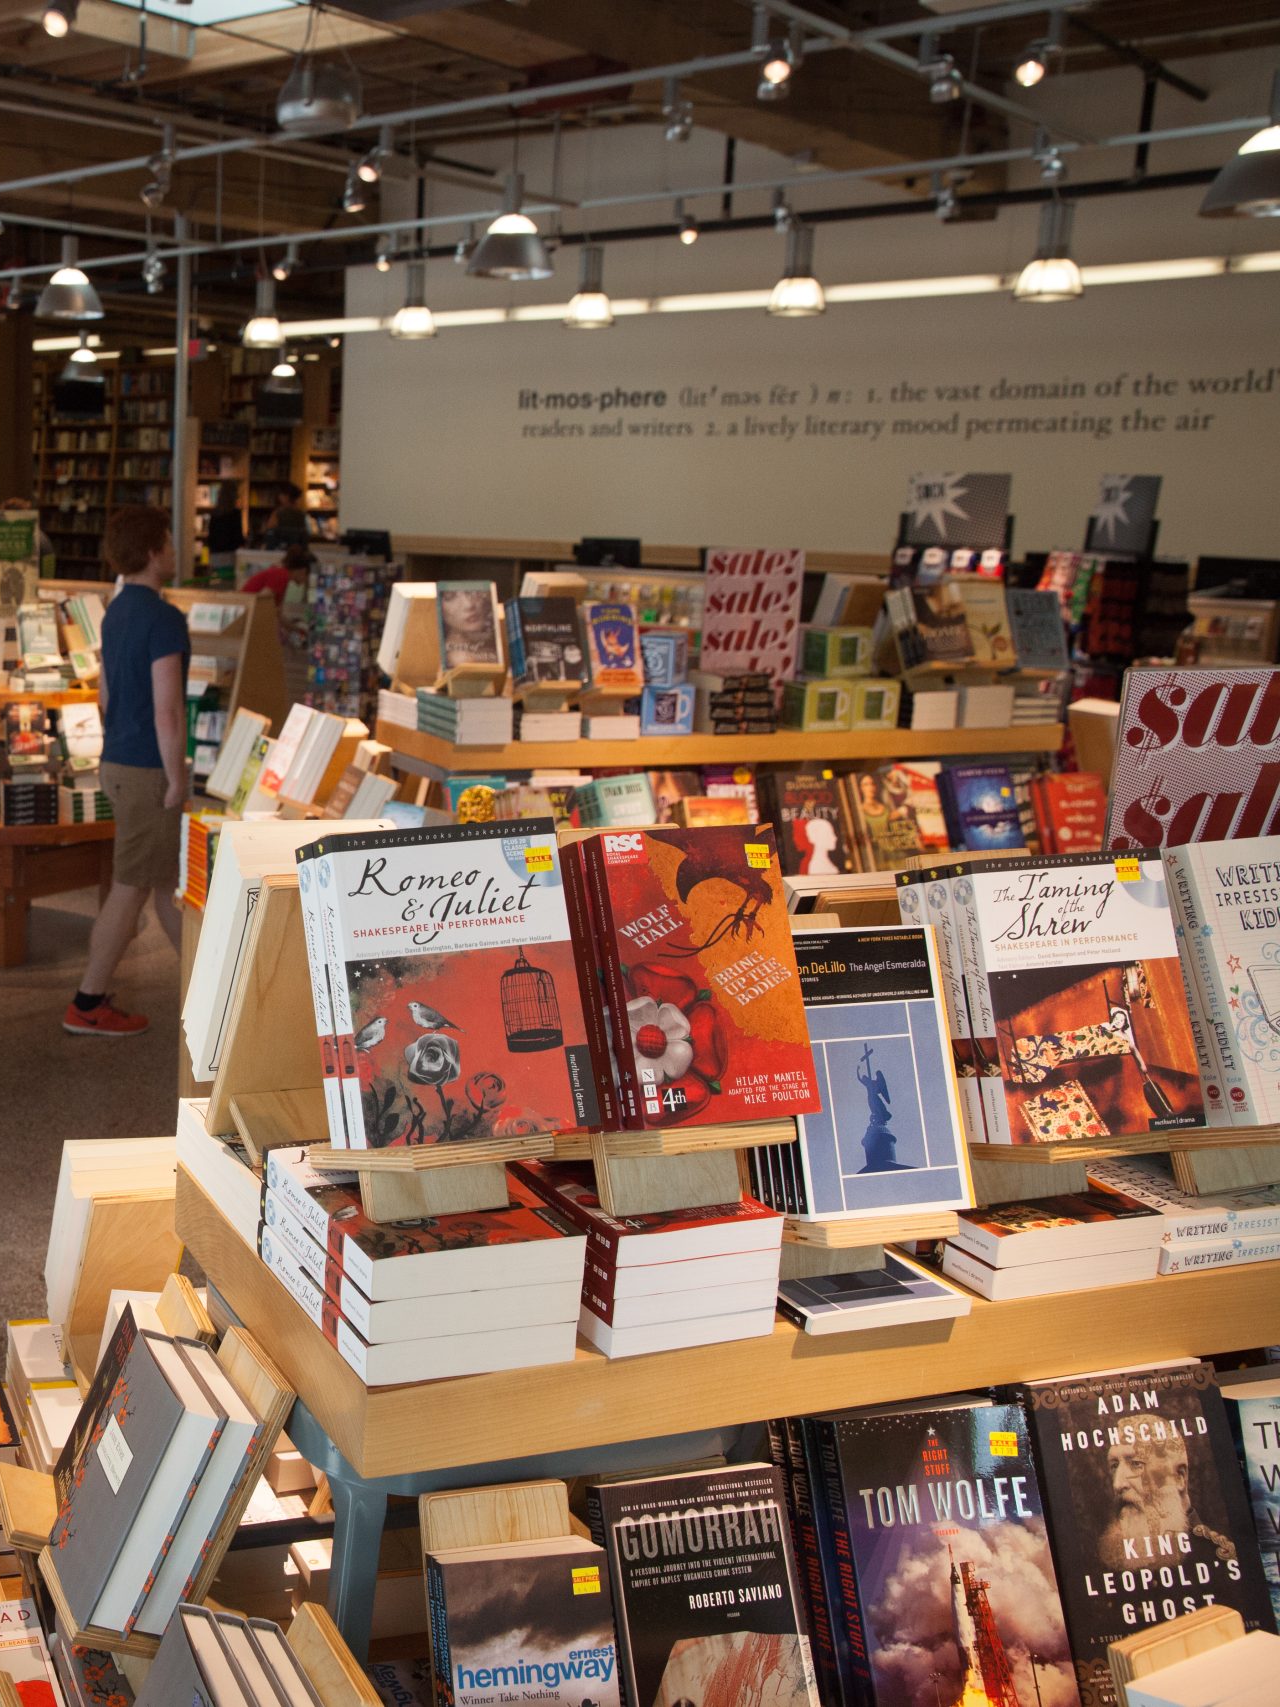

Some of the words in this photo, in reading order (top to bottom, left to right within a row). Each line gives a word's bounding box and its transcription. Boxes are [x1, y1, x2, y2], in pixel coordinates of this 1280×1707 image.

[890, 381, 927, 402] the
[934, 383, 981, 401] vast
[989, 376, 1086, 400] domain
[1094, 372, 1128, 396] of
[1133, 373, 1178, 396] the
[522, 418, 584, 438] readers
[589, 418, 623, 437] and
[628, 419, 694, 437] writers
[745, 415, 799, 442] lively
[806, 414, 885, 442] literary
[892, 412, 959, 435] mood
[965, 410, 1112, 441] permeating
[1121, 408, 1166, 432] the
[1174, 408, 1216, 432] air
[708, 550, 799, 576] sale!
[706, 581, 797, 614] sale!
[703, 619, 794, 651] sale!
[781, 807, 839, 822] BEAUTY
[347, 839, 366, 847] the
[374, 832, 452, 845] sourcebooks
[460, 825, 538, 838] shakespeare
[603, 834, 643, 852] RSC
[985, 861, 1002, 869] the
[1008, 858, 1074, 867] sourcebooks
[1079, 851, 1149, 863] shakespeare
[348, 857, 482, 897] Romeo
[993, 888, 1016, 903] The
[1018, 872, 1115, 919] Taming
[401, 898, 424, 921] &
[413, 874, 541, 945] Juliet
[619, 904, 671, 939] WOLF
[990, 902, 1094, 943] Shrew
[352, 923, 430, 938] SHAKESPEARE
[433, 922, 444, 931] IN
[448, 914, 526, 929] PERFORMANCE
[632, 915, 684, 949] HALL
[405, 946, 420, 954] David
[422, 943, 453, 953] Bevington,
[454, 941, 477, 950] Barbara
[478, 939, 499, 948] Gaines
[499, 938, 511, 946] and
[512, 936, 527, 944] Peter
[529, 934, 552, 943] Holland
[994, 940, 1059, 952] SHAKESPEARE
[1073, 933, 1139, 945] PERFORMANCE
[713, 951, 766, 986] BRING
[722, 978, 748, 997] UP
[747, 957, 782, 988] THE
[812, 962, 846, 974] DeLillo
[849, 962, 863, 972] The
[864, 962, 885, 972] Angel
[886, 960, 926, 969] Esmeralda
[1192, 935, 1220, 1017] IRRESISTIBLE
[735, 966, 792, 1007] BODIES
[728, 1088, 753, 1096] ADAPTED
[736, 1075, 769, 1087] HILARY
[774, 1072, 807, 1082] MANTEL
[662, 1088, 687, 1112] 4th
[744, 1094, 767, 1105] MIKE
[772, 1090, 810, 1101] POULTON
[1176, 1222, 1229, 1238] WRITING
[1184, 1251, 1233, 1267] WRITING
[1097, 1390, 1159, 1415] ADAM
[1061, 1416, 1208, 1451] HOCHSCHILD
[922, 1449, 948, 1461] RIGHT
[924, 1464, 951, 1477] STUFF
[679, 1497, 695, 1505] MAJOR
[696, 1495, 715, 1503] MOTION
[716, 1492, 735, 1501] PICTURE
[736, 1491, 749, 1499] FROM
[759, 1488, 774, 1496] FILMS
[707, 1483, 743, 1492] INTERNATIONAL
[744, 1478, 773, 1489] BESTSELLER
[858, 1484, 921, 1529] TOM
[928, 1476, 1033, 1521] WOLFE
[619, 1499, 780, 1561] GOMORRAH
[833, 1529, 849, 1558] THE
[1123, 1532, 1192, 1560] KING
[635, 1565, 661, 1576] PERSONAL
[663, 1562, 686, 1573] JOURNEY
[688, 1560, 700, 1570] INTO
[702, 1559, 712, 1569] THE
[713, 1556, 734, 1568] VIOLENT
[735, 1551, 776, 1565] INTERNATIONAL
[631, 1578, 651, 1589] EMPIRE
[652, 1578, 659, 1586] OF
[683, 1571, 712, 1582] ORGANIZED
[713, 1569, 730, 1579] CRIME
[731, 1566, 752, 1577] SYSTEM
[807, 1554, 823, 1602] RIGHT
[839, 1559, 856, 1606] RIGHT
[1085, 1559, 1241, 1596] LEOPOLD'S
[689, 1590, 735, 1610] ROBERTO
[739, 1584, 782, 1603] SAVIANO
[1122, 1594, 1215, 1624] GHOST
[846, 1610, 866, 1659] STUFF
[569, 1645, 614, 1660] ernest
[457, 1656, 615, 1689] hemingway
[460, 1694, 494, 1706] Winner
[498, 1692, 519, 1703] Take
[522, 1689, 560, 1701] Nothing
